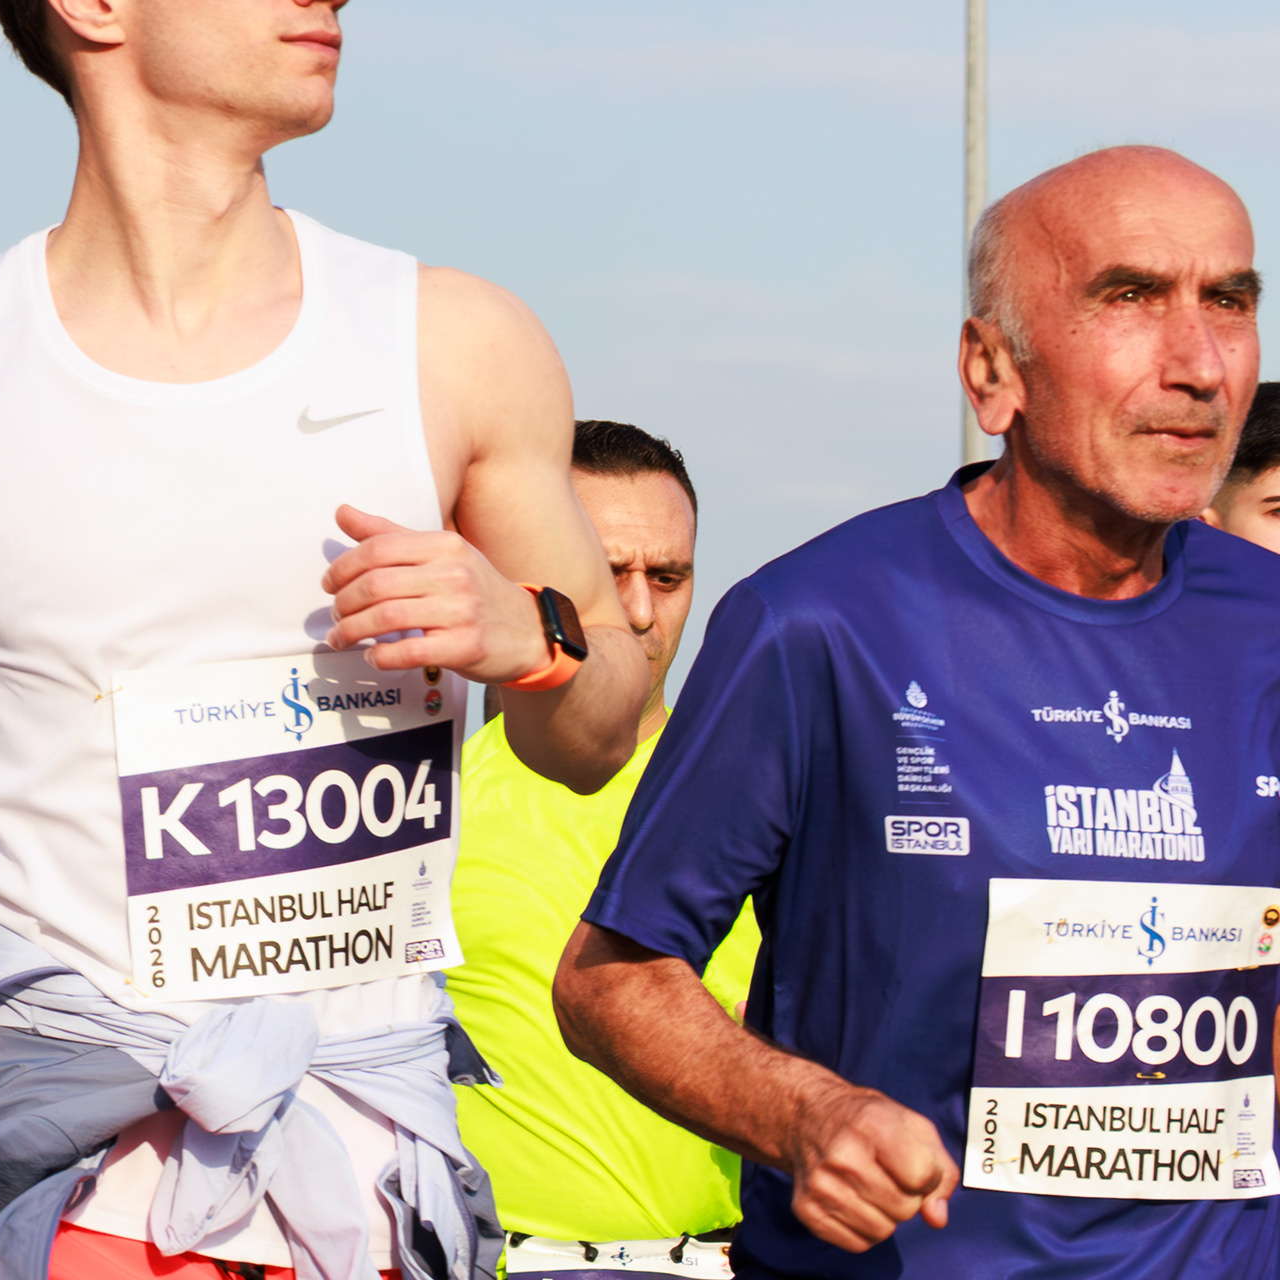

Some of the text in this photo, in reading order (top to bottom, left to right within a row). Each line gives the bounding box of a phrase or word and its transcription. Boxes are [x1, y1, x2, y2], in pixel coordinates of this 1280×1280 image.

[174, 699, 276, 725] TÜRKİYE
[317, 688, 401, 712] BANKASI
[1031, 706, 1104, 722] TÜRKİYE
[1128, 711, 1192, 730] BANKASI
[141, 759, 442, 859] K 13004
[1044, 785, 1202, 835] İSTANBUL
[891, 821, 961, 839] SPOR
[1047, 827, 1205, 862] YARI MARATONU
[187, 890, 333, 931] ISTANBUL
[337, 881, 394, 916] HALF
[1044, 920, 1132, 940] TÜRKİYE
[1171, 926, 1242, 943] BANKASI
[190, 925, 393, 982] MARATHON
[1042, 992, 1258, 1066] 10800
[1024, 1102, 1225, 1134] ISTANBUL HALF
[1019, 1142, 1220, 1182] MARATHON
